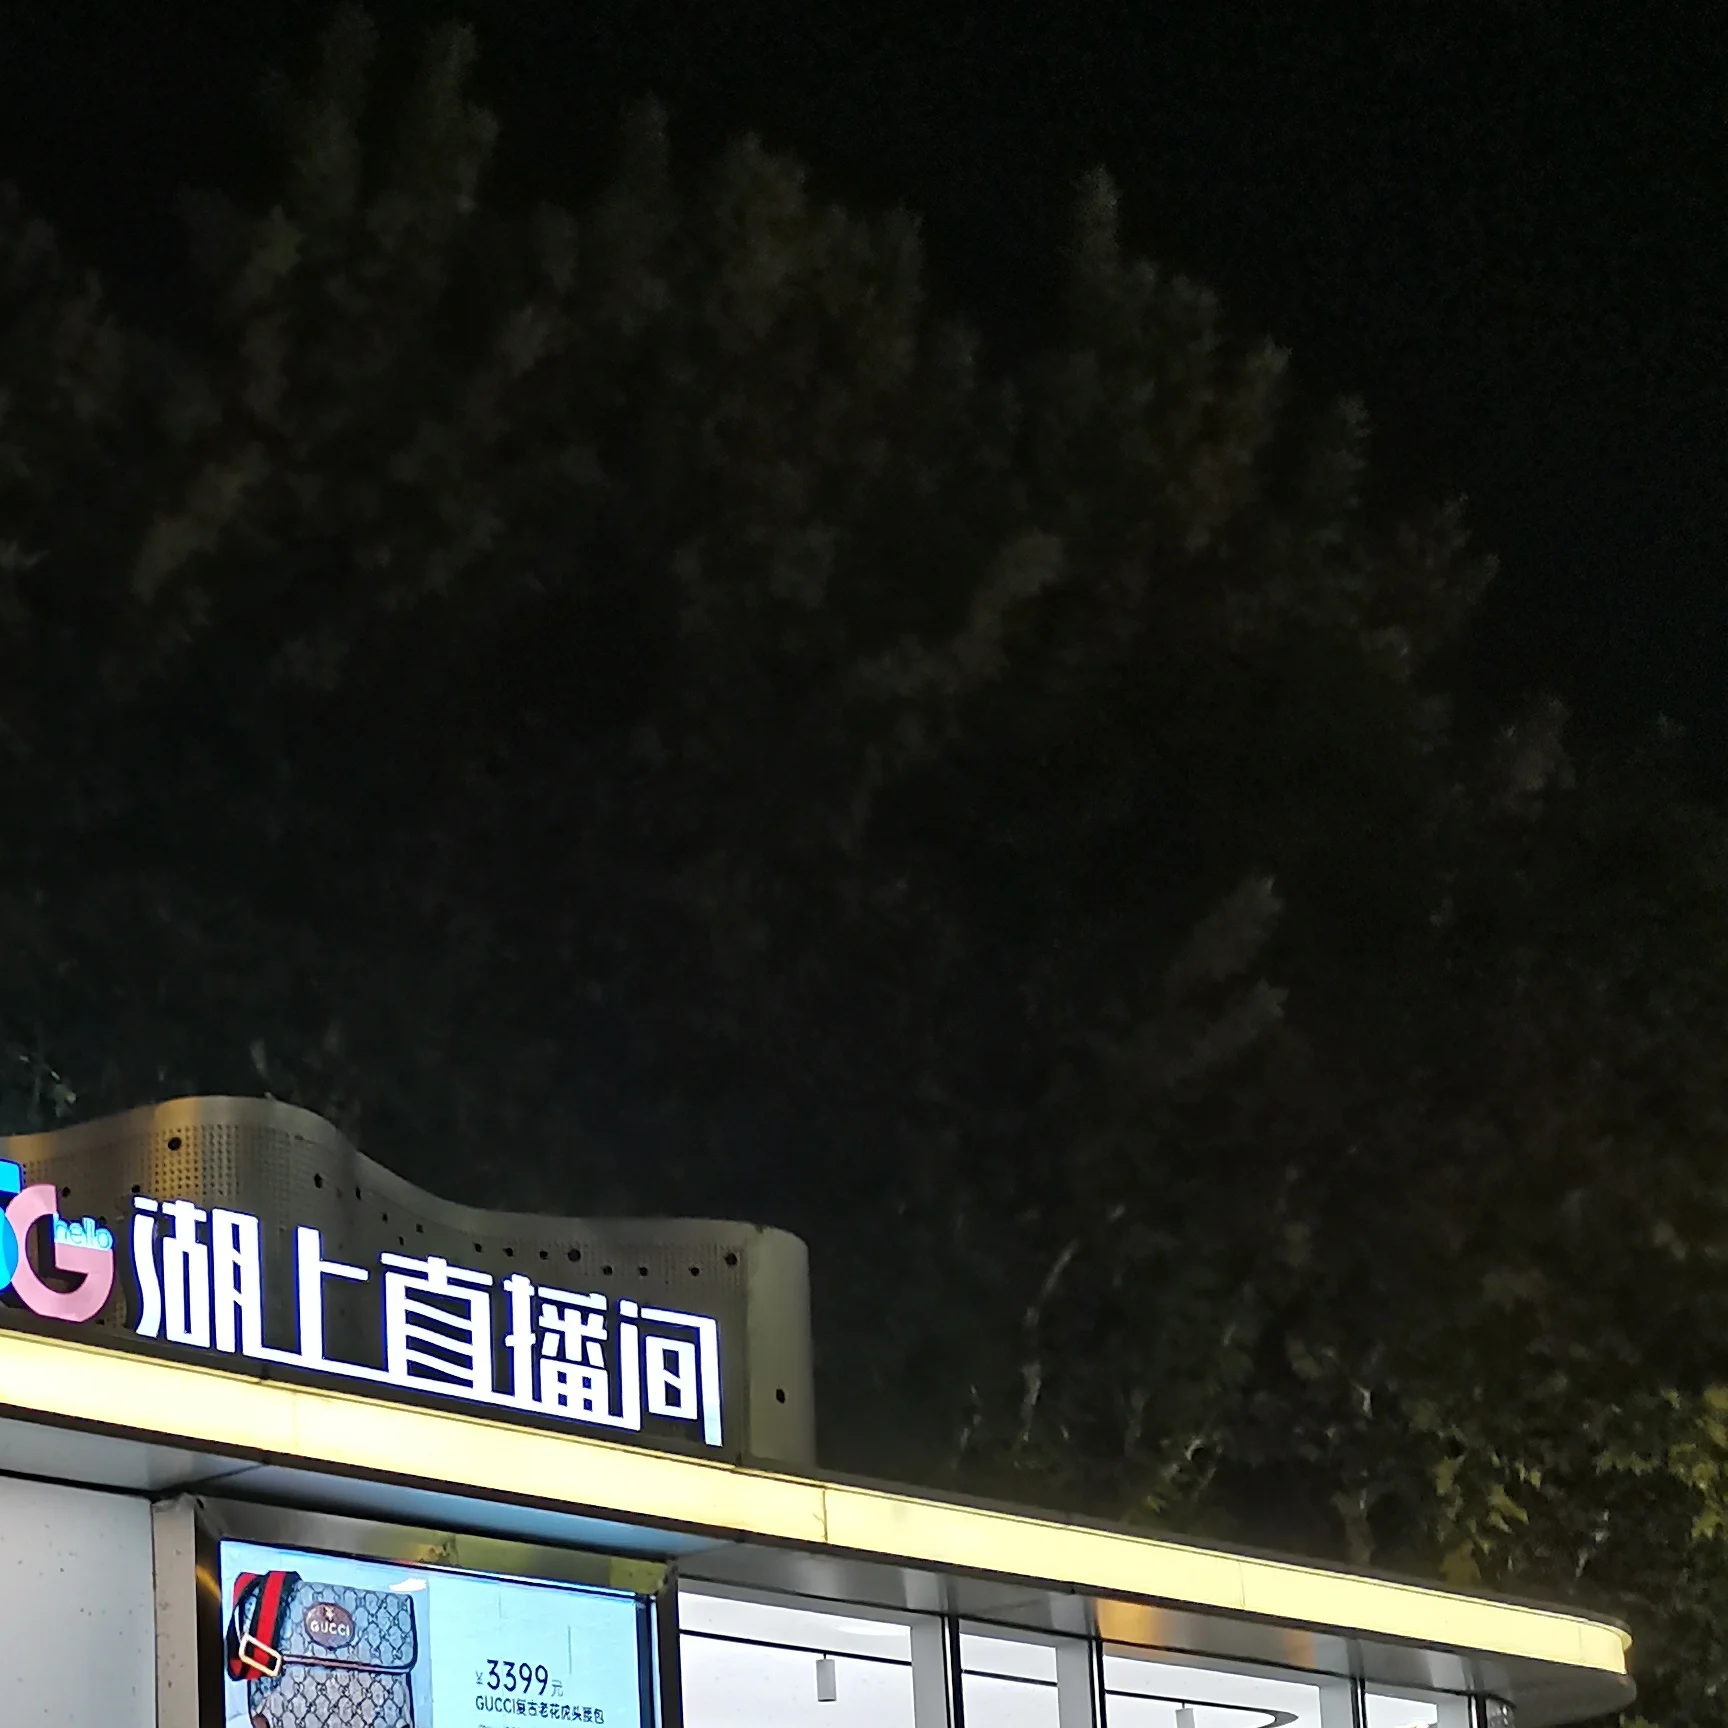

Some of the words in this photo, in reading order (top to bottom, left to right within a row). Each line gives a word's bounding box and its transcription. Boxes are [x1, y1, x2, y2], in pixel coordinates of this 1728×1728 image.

[53, 1211, 114, 1252] hello
[131, 1197, 723, 1447] 湖上直播间
[310, 1620, 350, 1637] GUCCI
